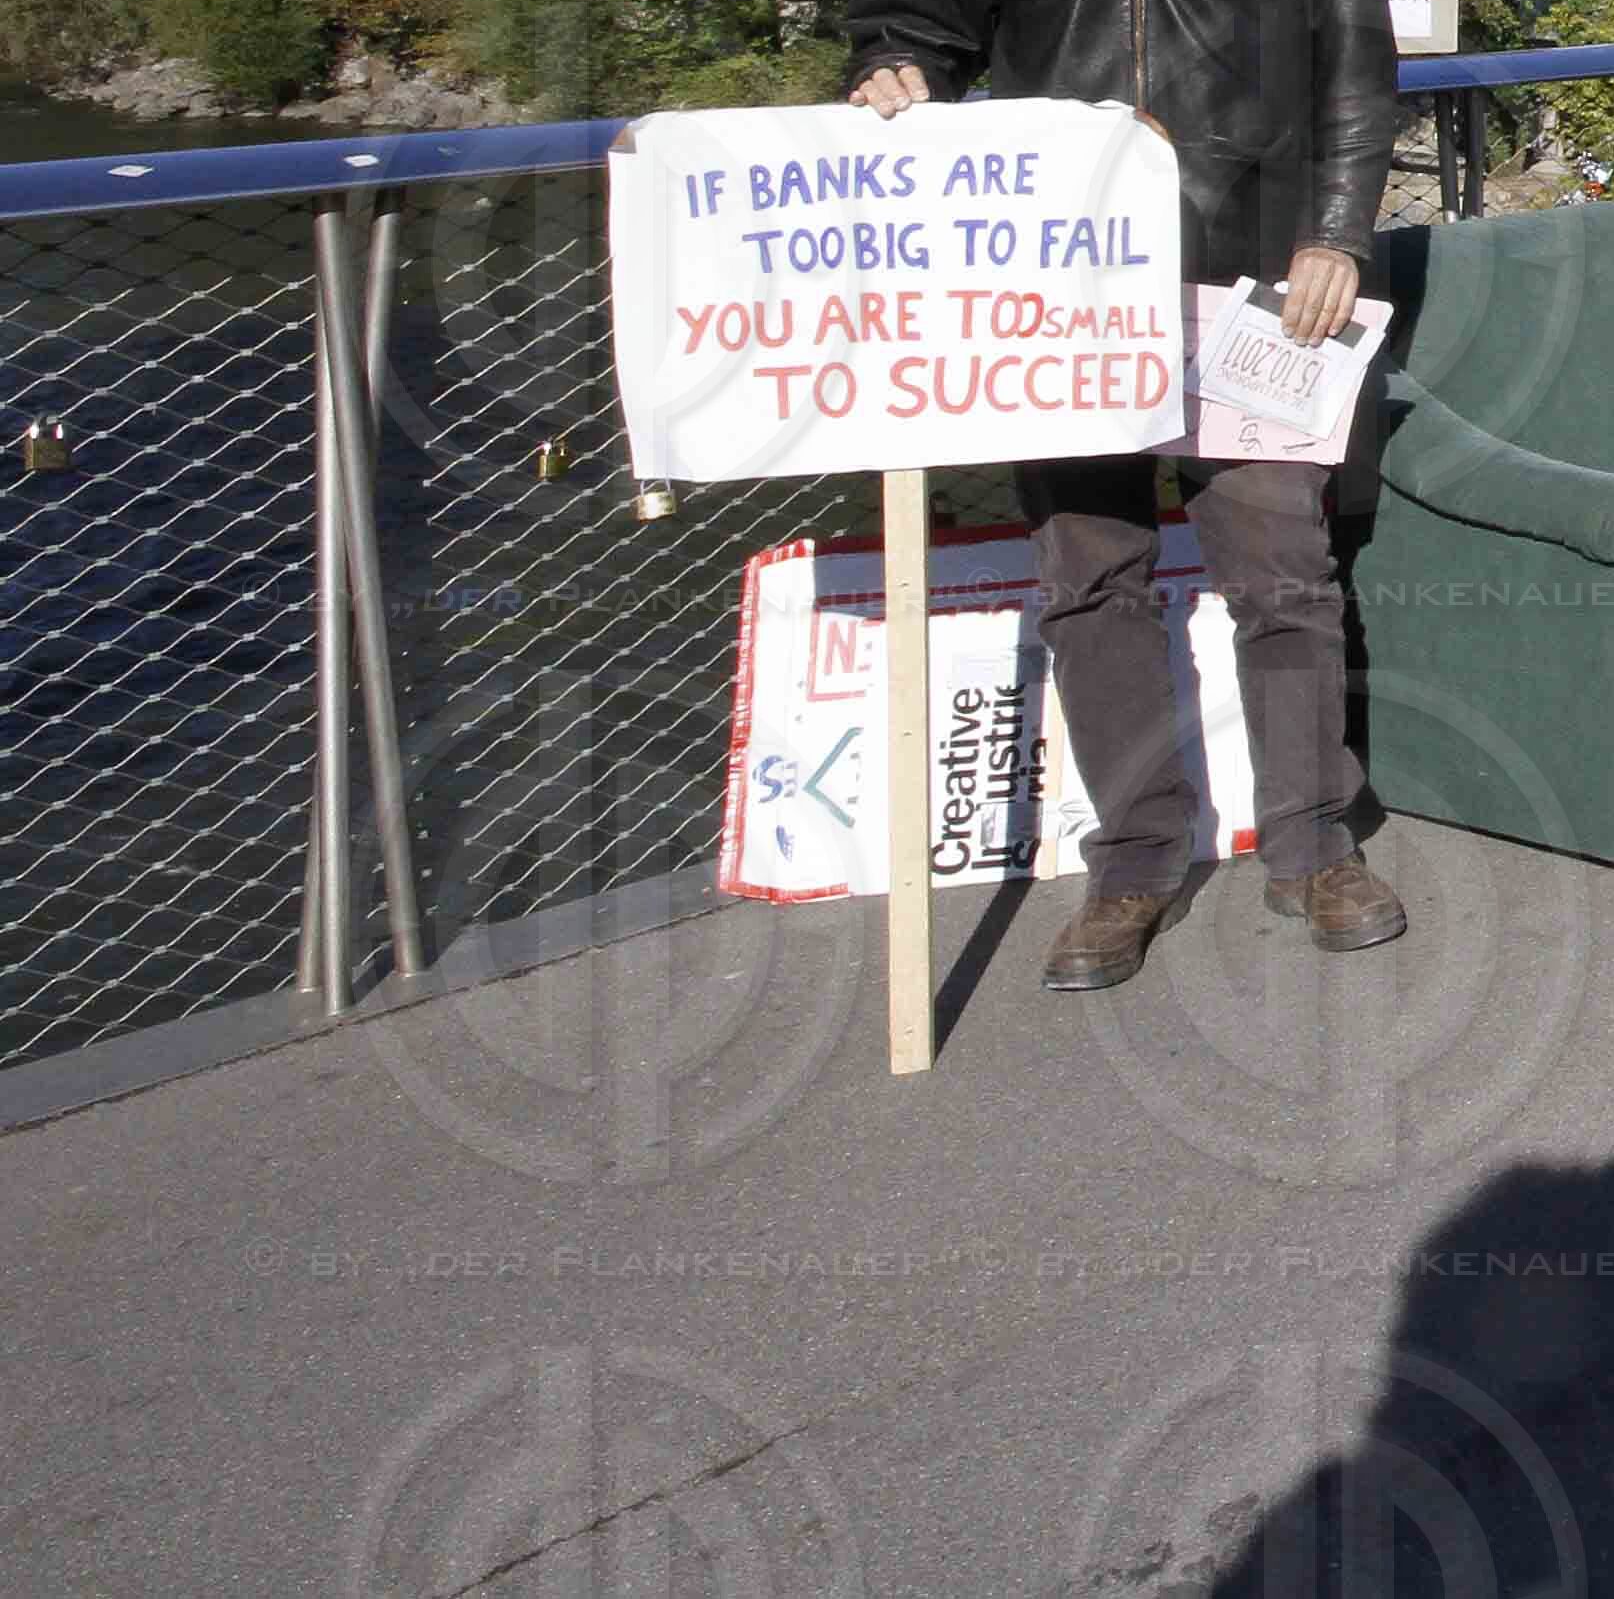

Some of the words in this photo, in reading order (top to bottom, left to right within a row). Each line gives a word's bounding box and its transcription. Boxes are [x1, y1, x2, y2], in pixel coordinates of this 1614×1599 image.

[686, 170, 726, 218] IF
[749, 154, 916, 211] BANKS
[943, 153, 1039, 197] ARE
[953, 219, 1016, 267] TO
[1039, 217, 1150, 269] FAIL
[677, 298, 793, 354] YOU
[814, 292, 923, 346] ARE
[753, 362, 857, 420] TO
[886, 350, 1169, 419] SUCCEED
[929, 686, 984, 877] Creative
